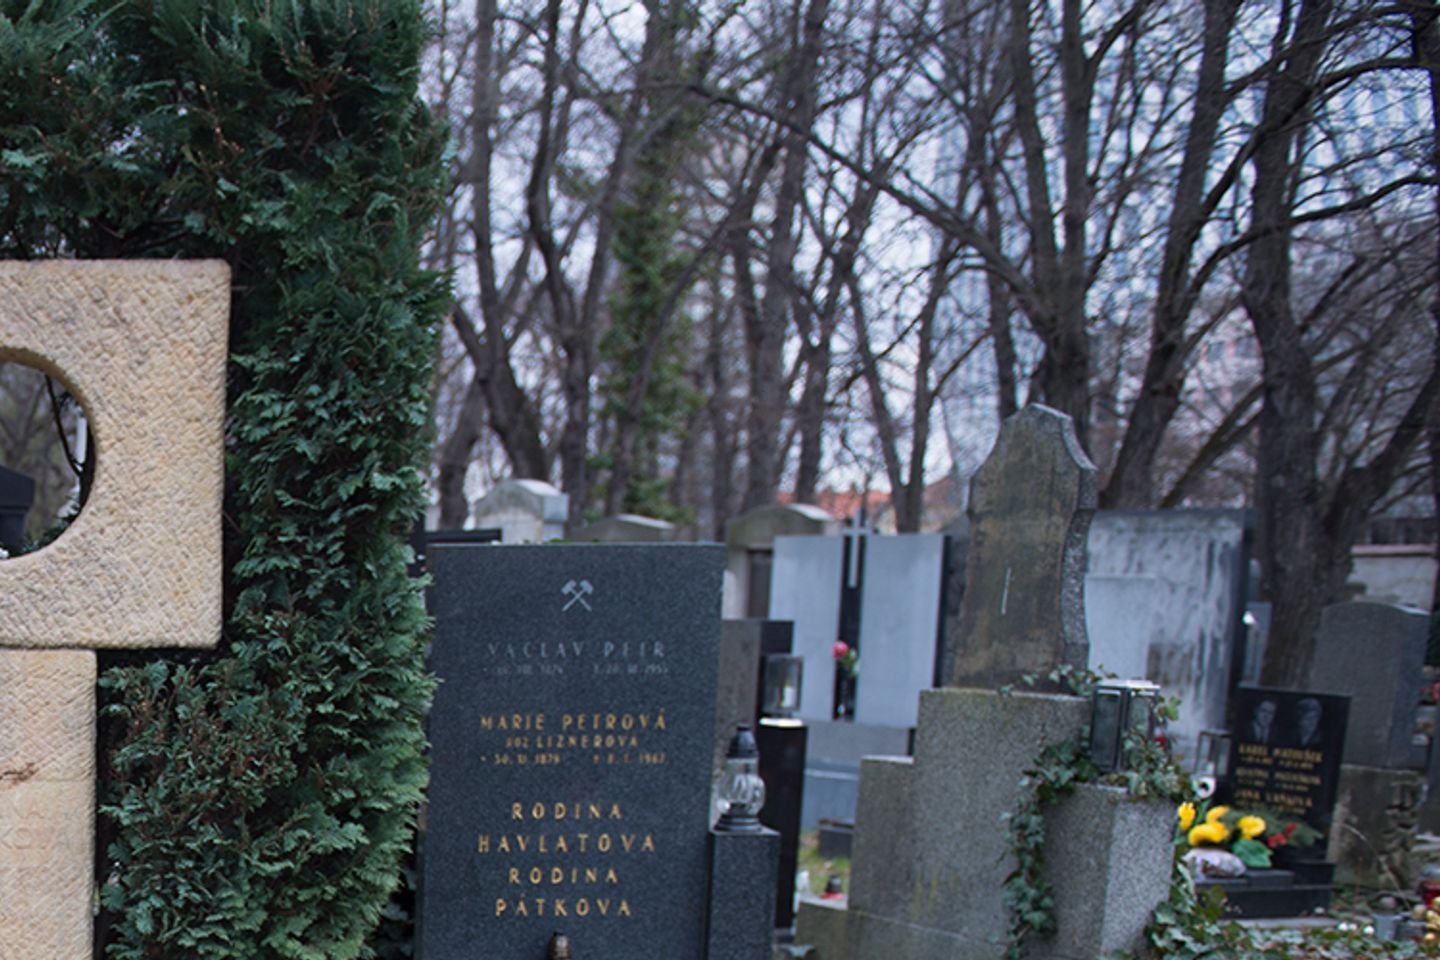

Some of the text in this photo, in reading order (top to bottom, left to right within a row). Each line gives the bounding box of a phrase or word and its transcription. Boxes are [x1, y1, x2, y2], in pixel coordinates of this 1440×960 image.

[479, 713, 545, 731] MARIE
[511, 802, 623, 819] RODINA
[478, 834, 656, 853] HAVLATOVA
[509, 867, 618, 884] RODINA
[495, 892, 632, 917] PÁTKOVA
